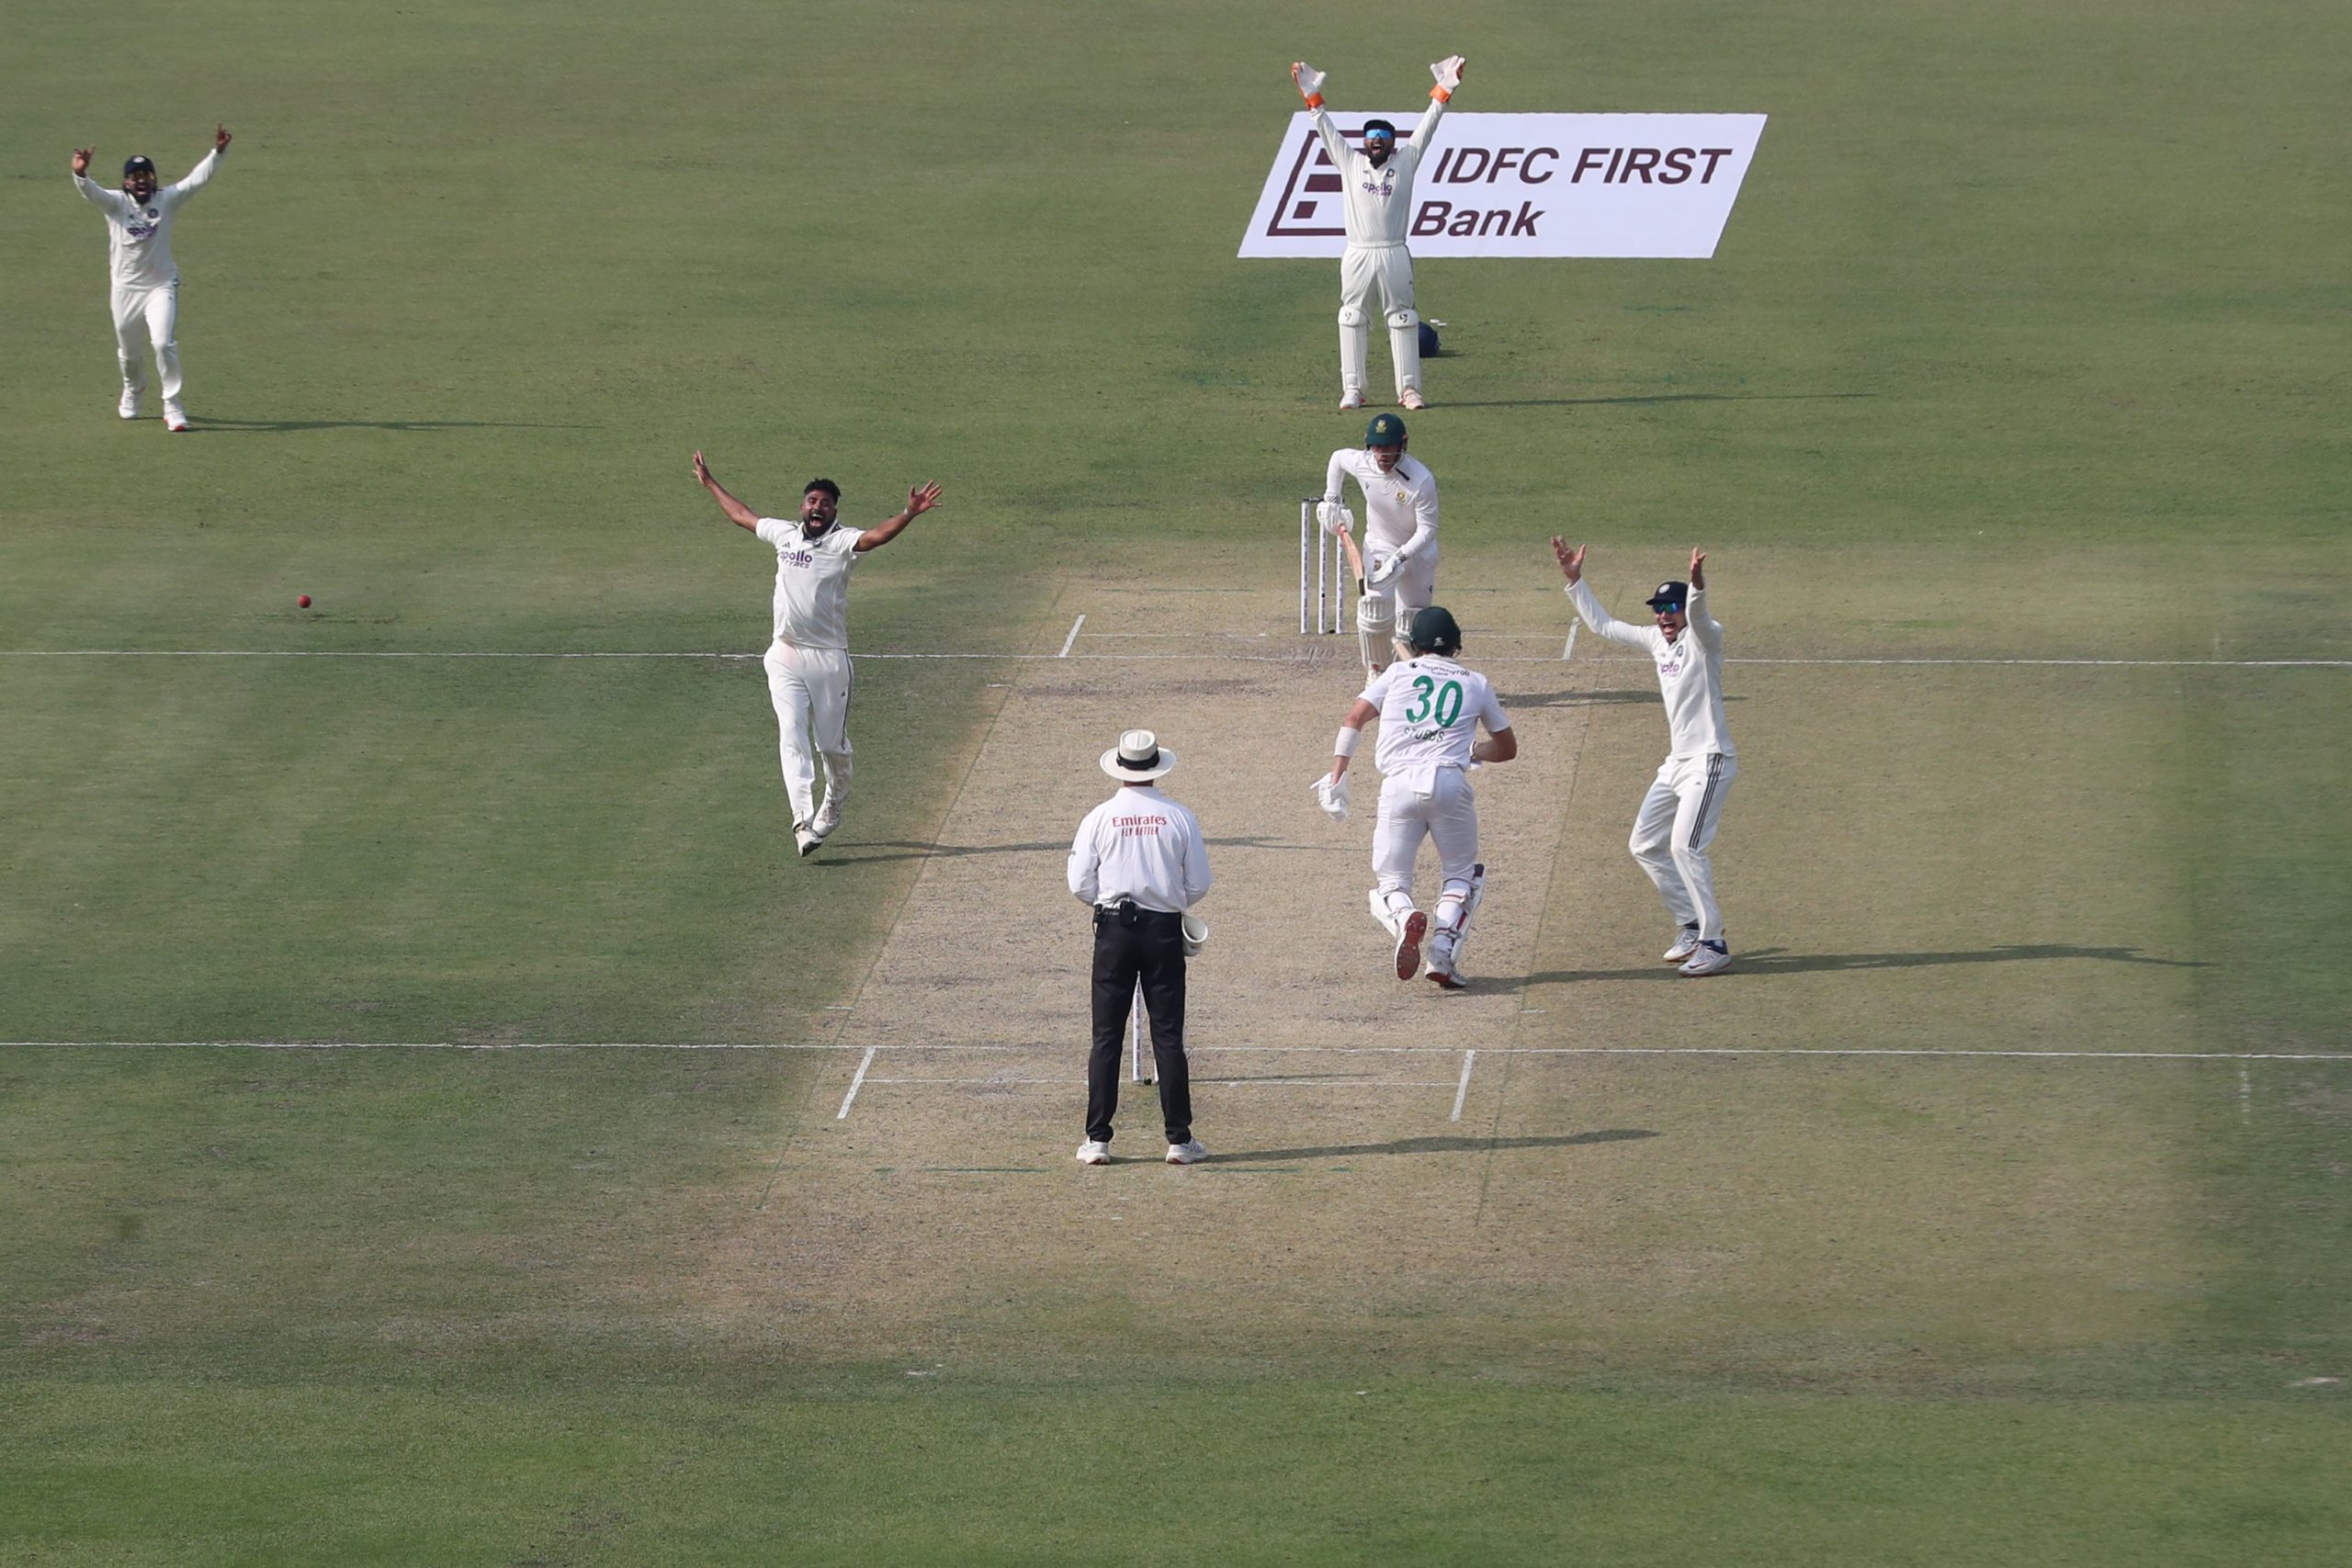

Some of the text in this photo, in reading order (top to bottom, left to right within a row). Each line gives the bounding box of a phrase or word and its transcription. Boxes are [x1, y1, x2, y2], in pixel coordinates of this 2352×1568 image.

[1431, 147, 1734, 185] IDFC FIRST
[1409, 199, 1545, 237] Bank
[1406, 674, 1464, 728] 30
[1112, 814, 1168, 828] Emirates
